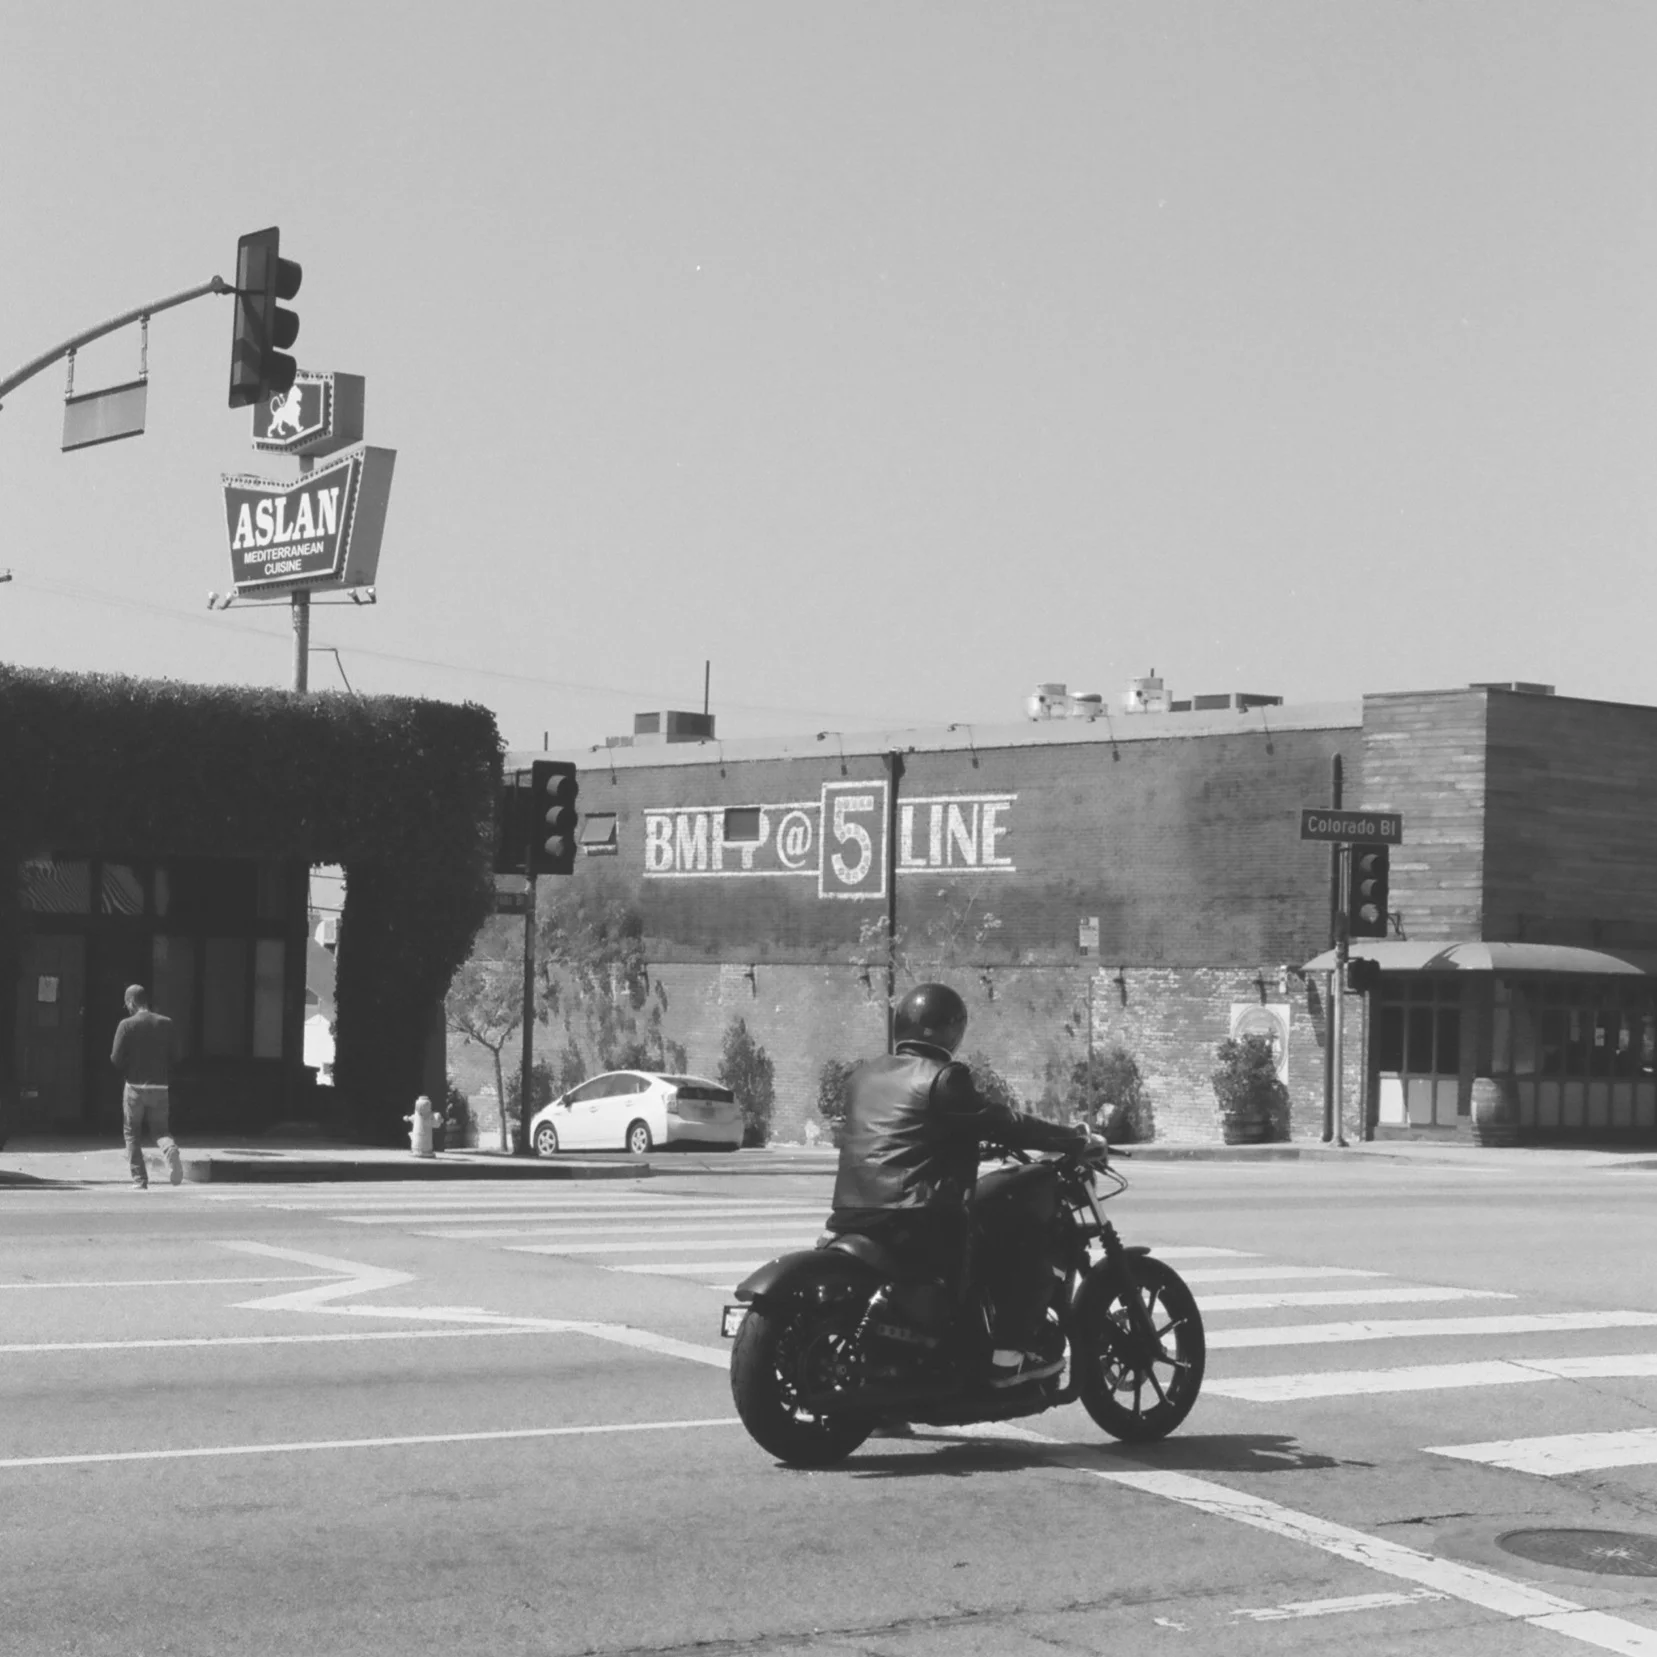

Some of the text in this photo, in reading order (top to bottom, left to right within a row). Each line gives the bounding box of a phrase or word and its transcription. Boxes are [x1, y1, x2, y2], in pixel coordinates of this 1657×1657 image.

[232, 487, 339, 549] ASLAN
[244, 541, 324, 563] MEDITERRANEAN
[265, 559, 302, 575] CUISINE
[1308, 816, 1396, 836] Colorado Bl
[831, 796, 874, 885] 5
[901, 802, 1011, 865] LINE
